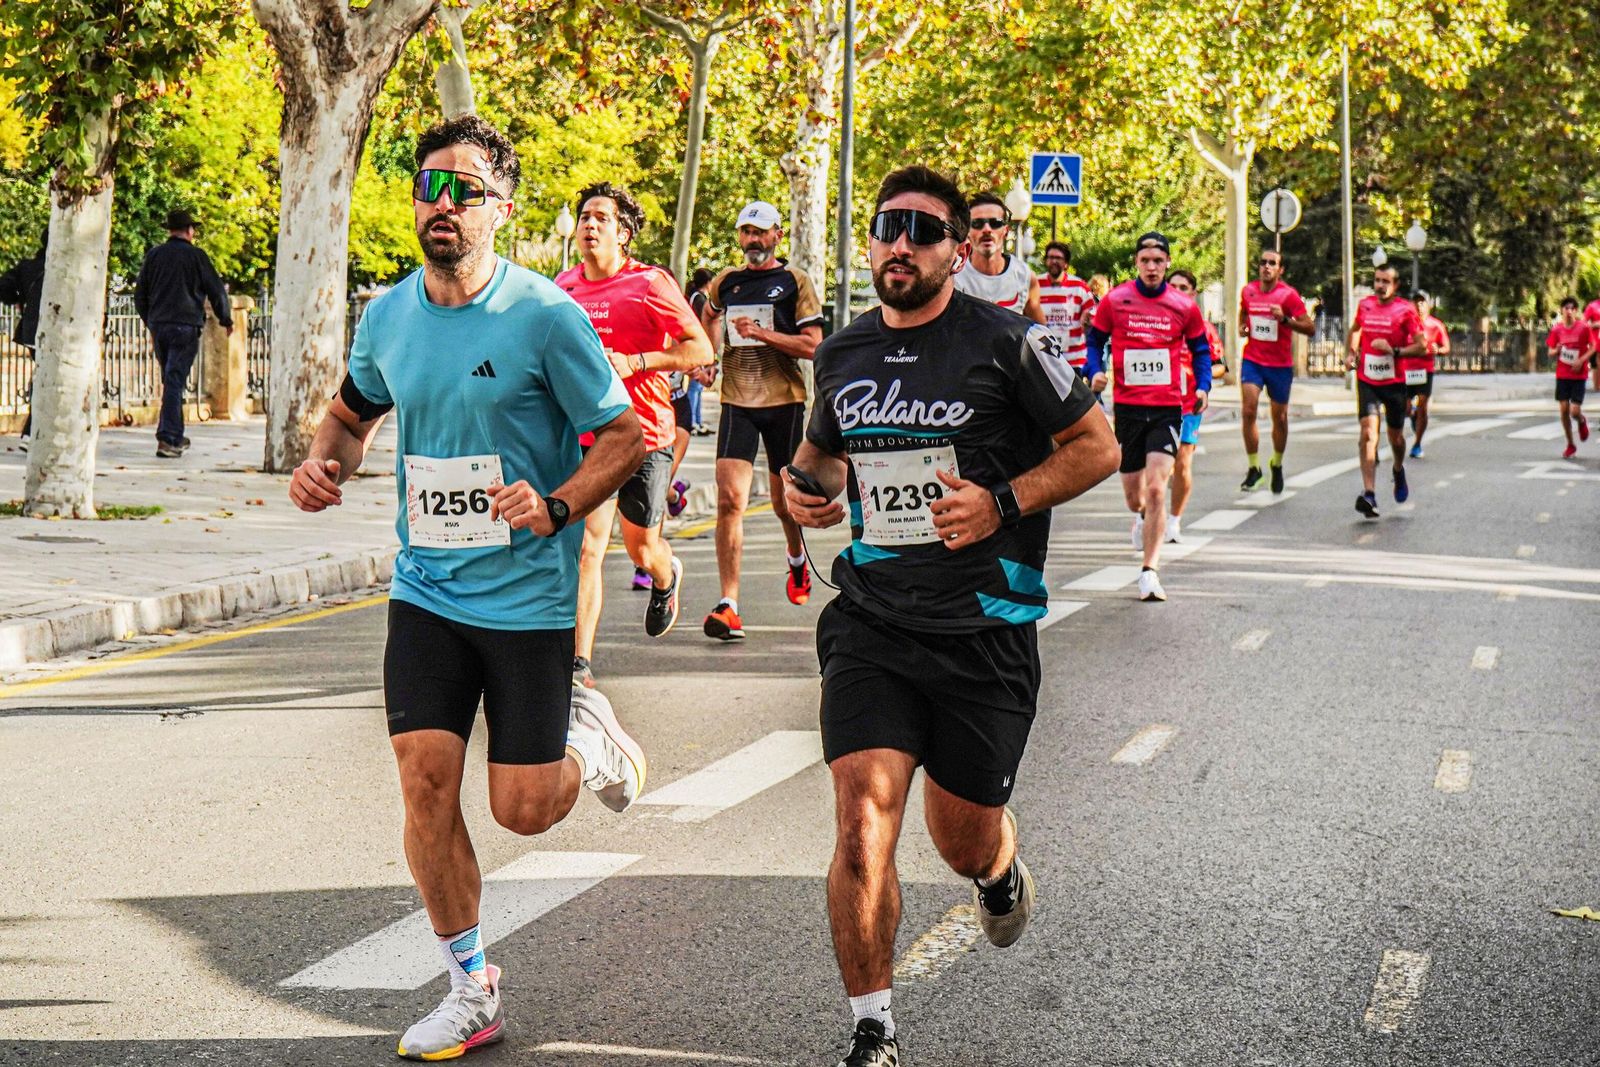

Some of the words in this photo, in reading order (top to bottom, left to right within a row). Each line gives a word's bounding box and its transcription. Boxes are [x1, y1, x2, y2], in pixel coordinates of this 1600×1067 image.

[1128, 320, 1171, 331] humanidad
[1131, 361, 1163, 373] 1319
[833, 378, 975, 431] Balance
[418, 488, 489, 516] 1256
[869, 481, 944, 512] 1239
